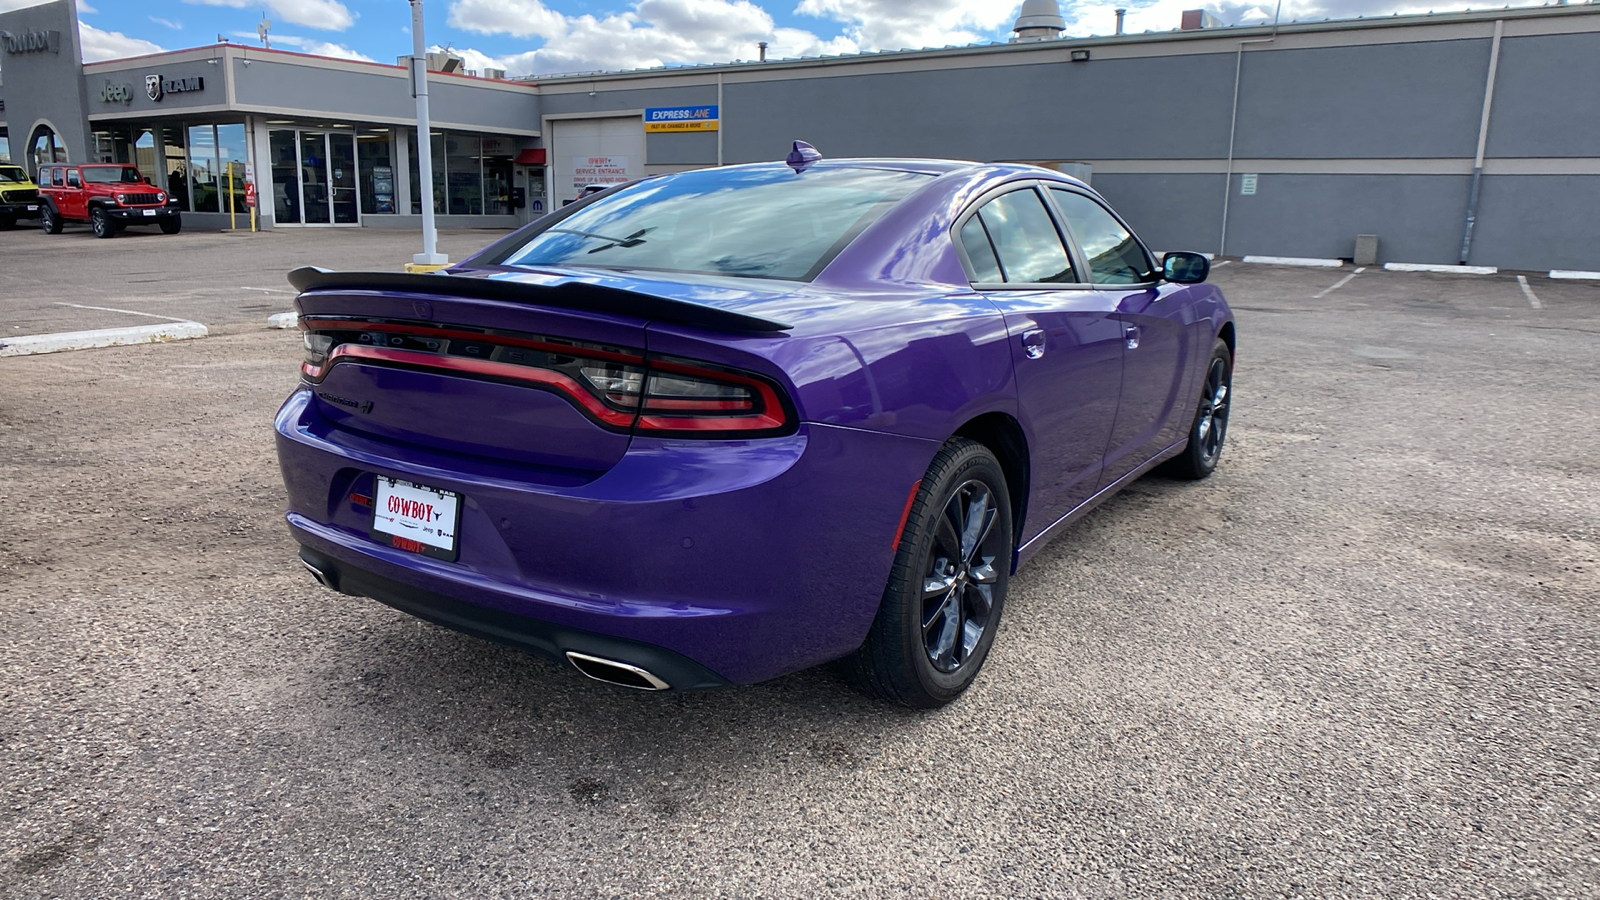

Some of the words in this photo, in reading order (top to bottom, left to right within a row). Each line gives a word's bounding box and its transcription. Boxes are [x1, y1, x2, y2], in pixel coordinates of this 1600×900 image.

[99, 79, 133, 106] Jeep
[162, 77, 203, 94] RAM
[359, 333, 524, 361] DODGE
[439, 489, 455, 497] RAM
[388, 495, 433, 522] COWBOY
[423, 526, 433, 534] Jeep
[392, 535, 421, 553] COWBOY
